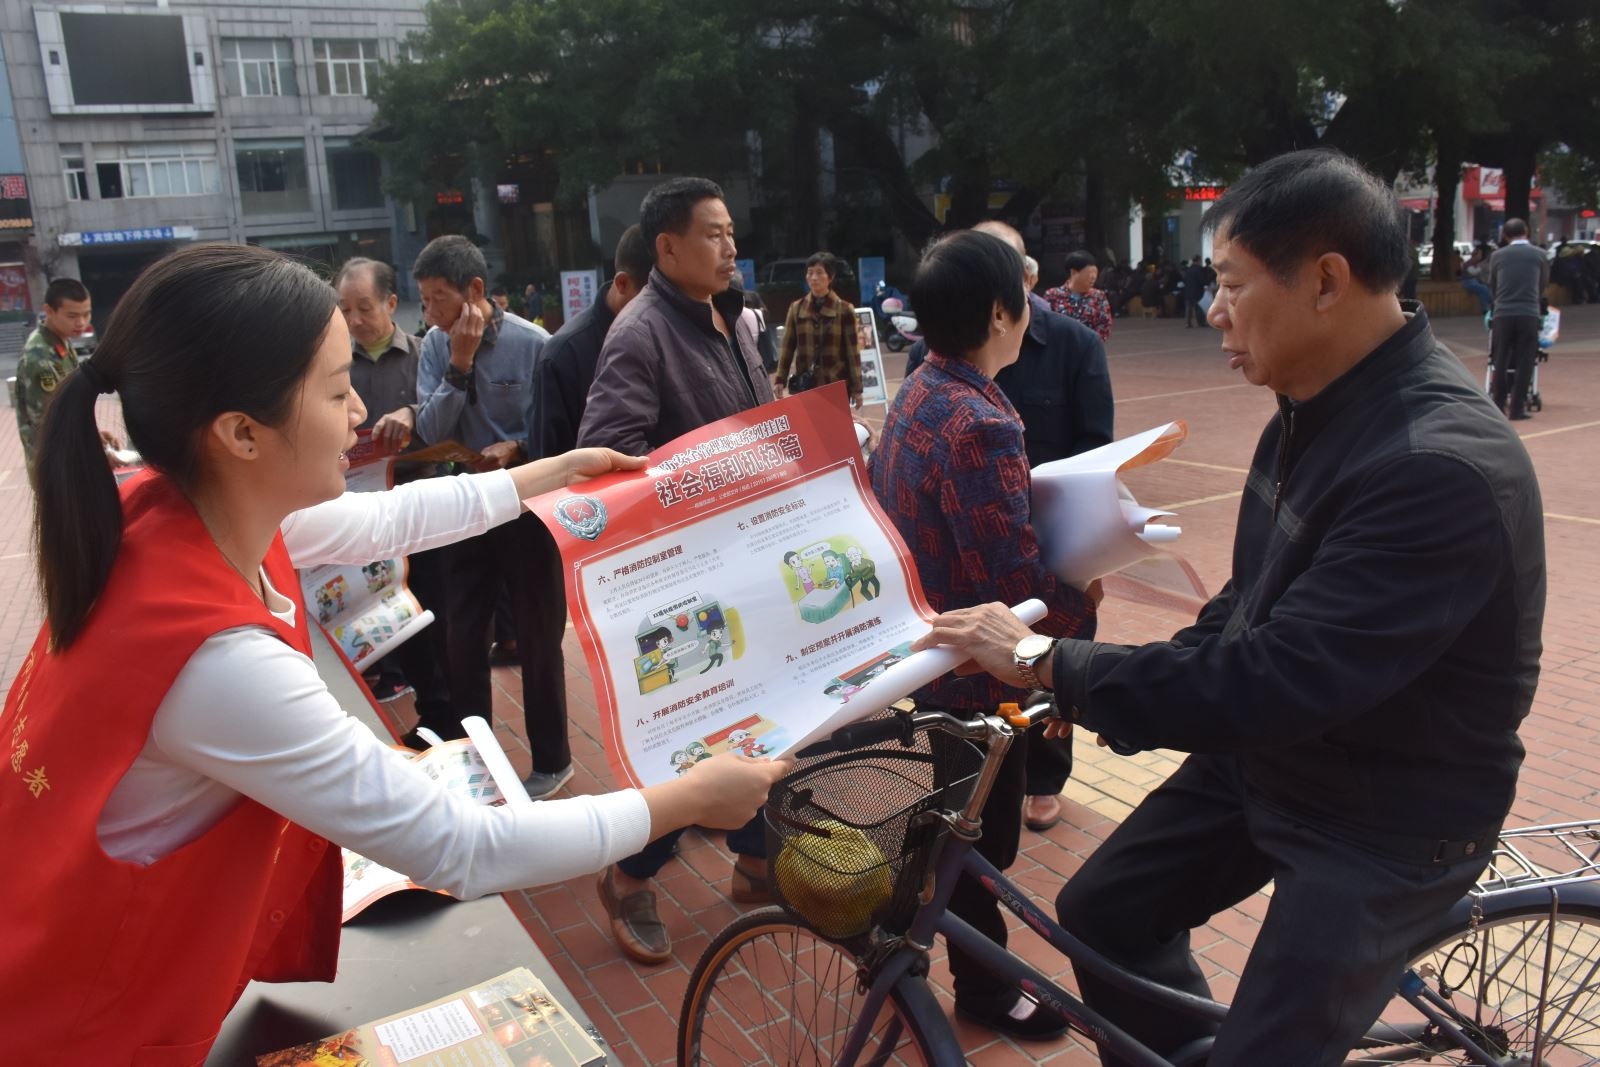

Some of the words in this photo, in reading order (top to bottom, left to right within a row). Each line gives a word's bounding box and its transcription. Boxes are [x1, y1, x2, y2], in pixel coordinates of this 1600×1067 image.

[645, 414, 790, 477] 防安全管理规定系列挂图
[655, 433, 804, 509] 社会福利机构篇
[736, 498, 807, 531] 七、设置消防安全标识
[597, 544, 684, 586] 六、严格消防控制室管理
[785, 616, 883, 663] 九、制定预案并开展消防演练
[636, 678, 735, 727] 八、开展消防安全教育培训
